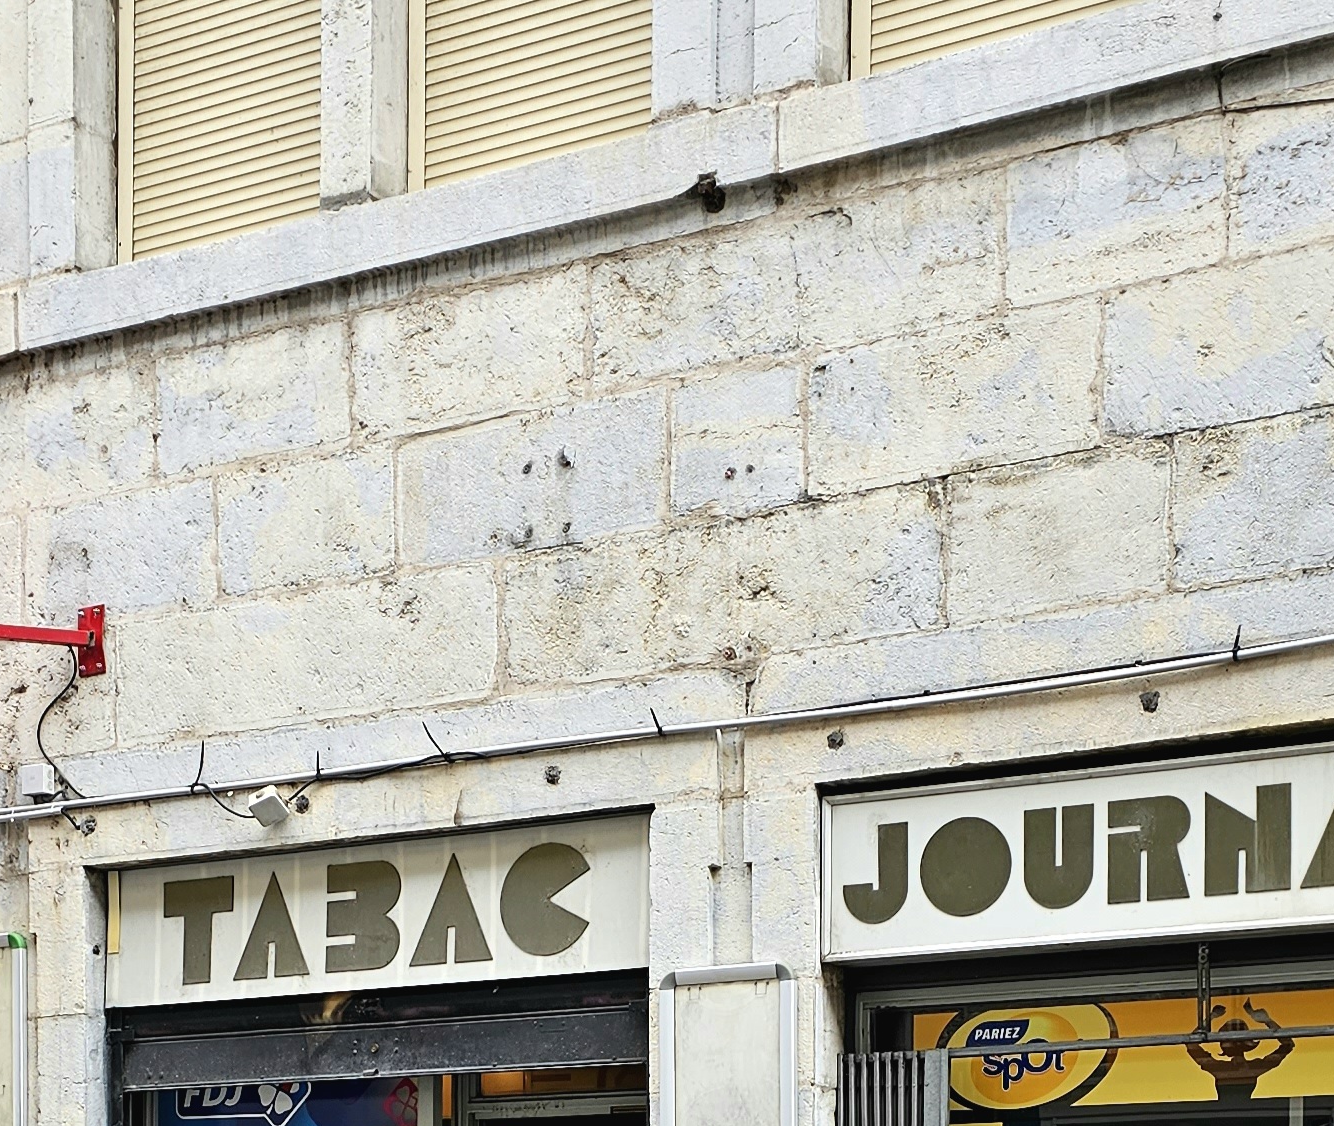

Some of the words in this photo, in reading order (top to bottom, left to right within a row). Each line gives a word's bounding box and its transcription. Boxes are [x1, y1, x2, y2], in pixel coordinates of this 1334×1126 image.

[163, 842, 591, 985] TABAC
[975, 1026, 1021, 1041] PARIEZ
[183, 1086, 243, 1108] FDJ
